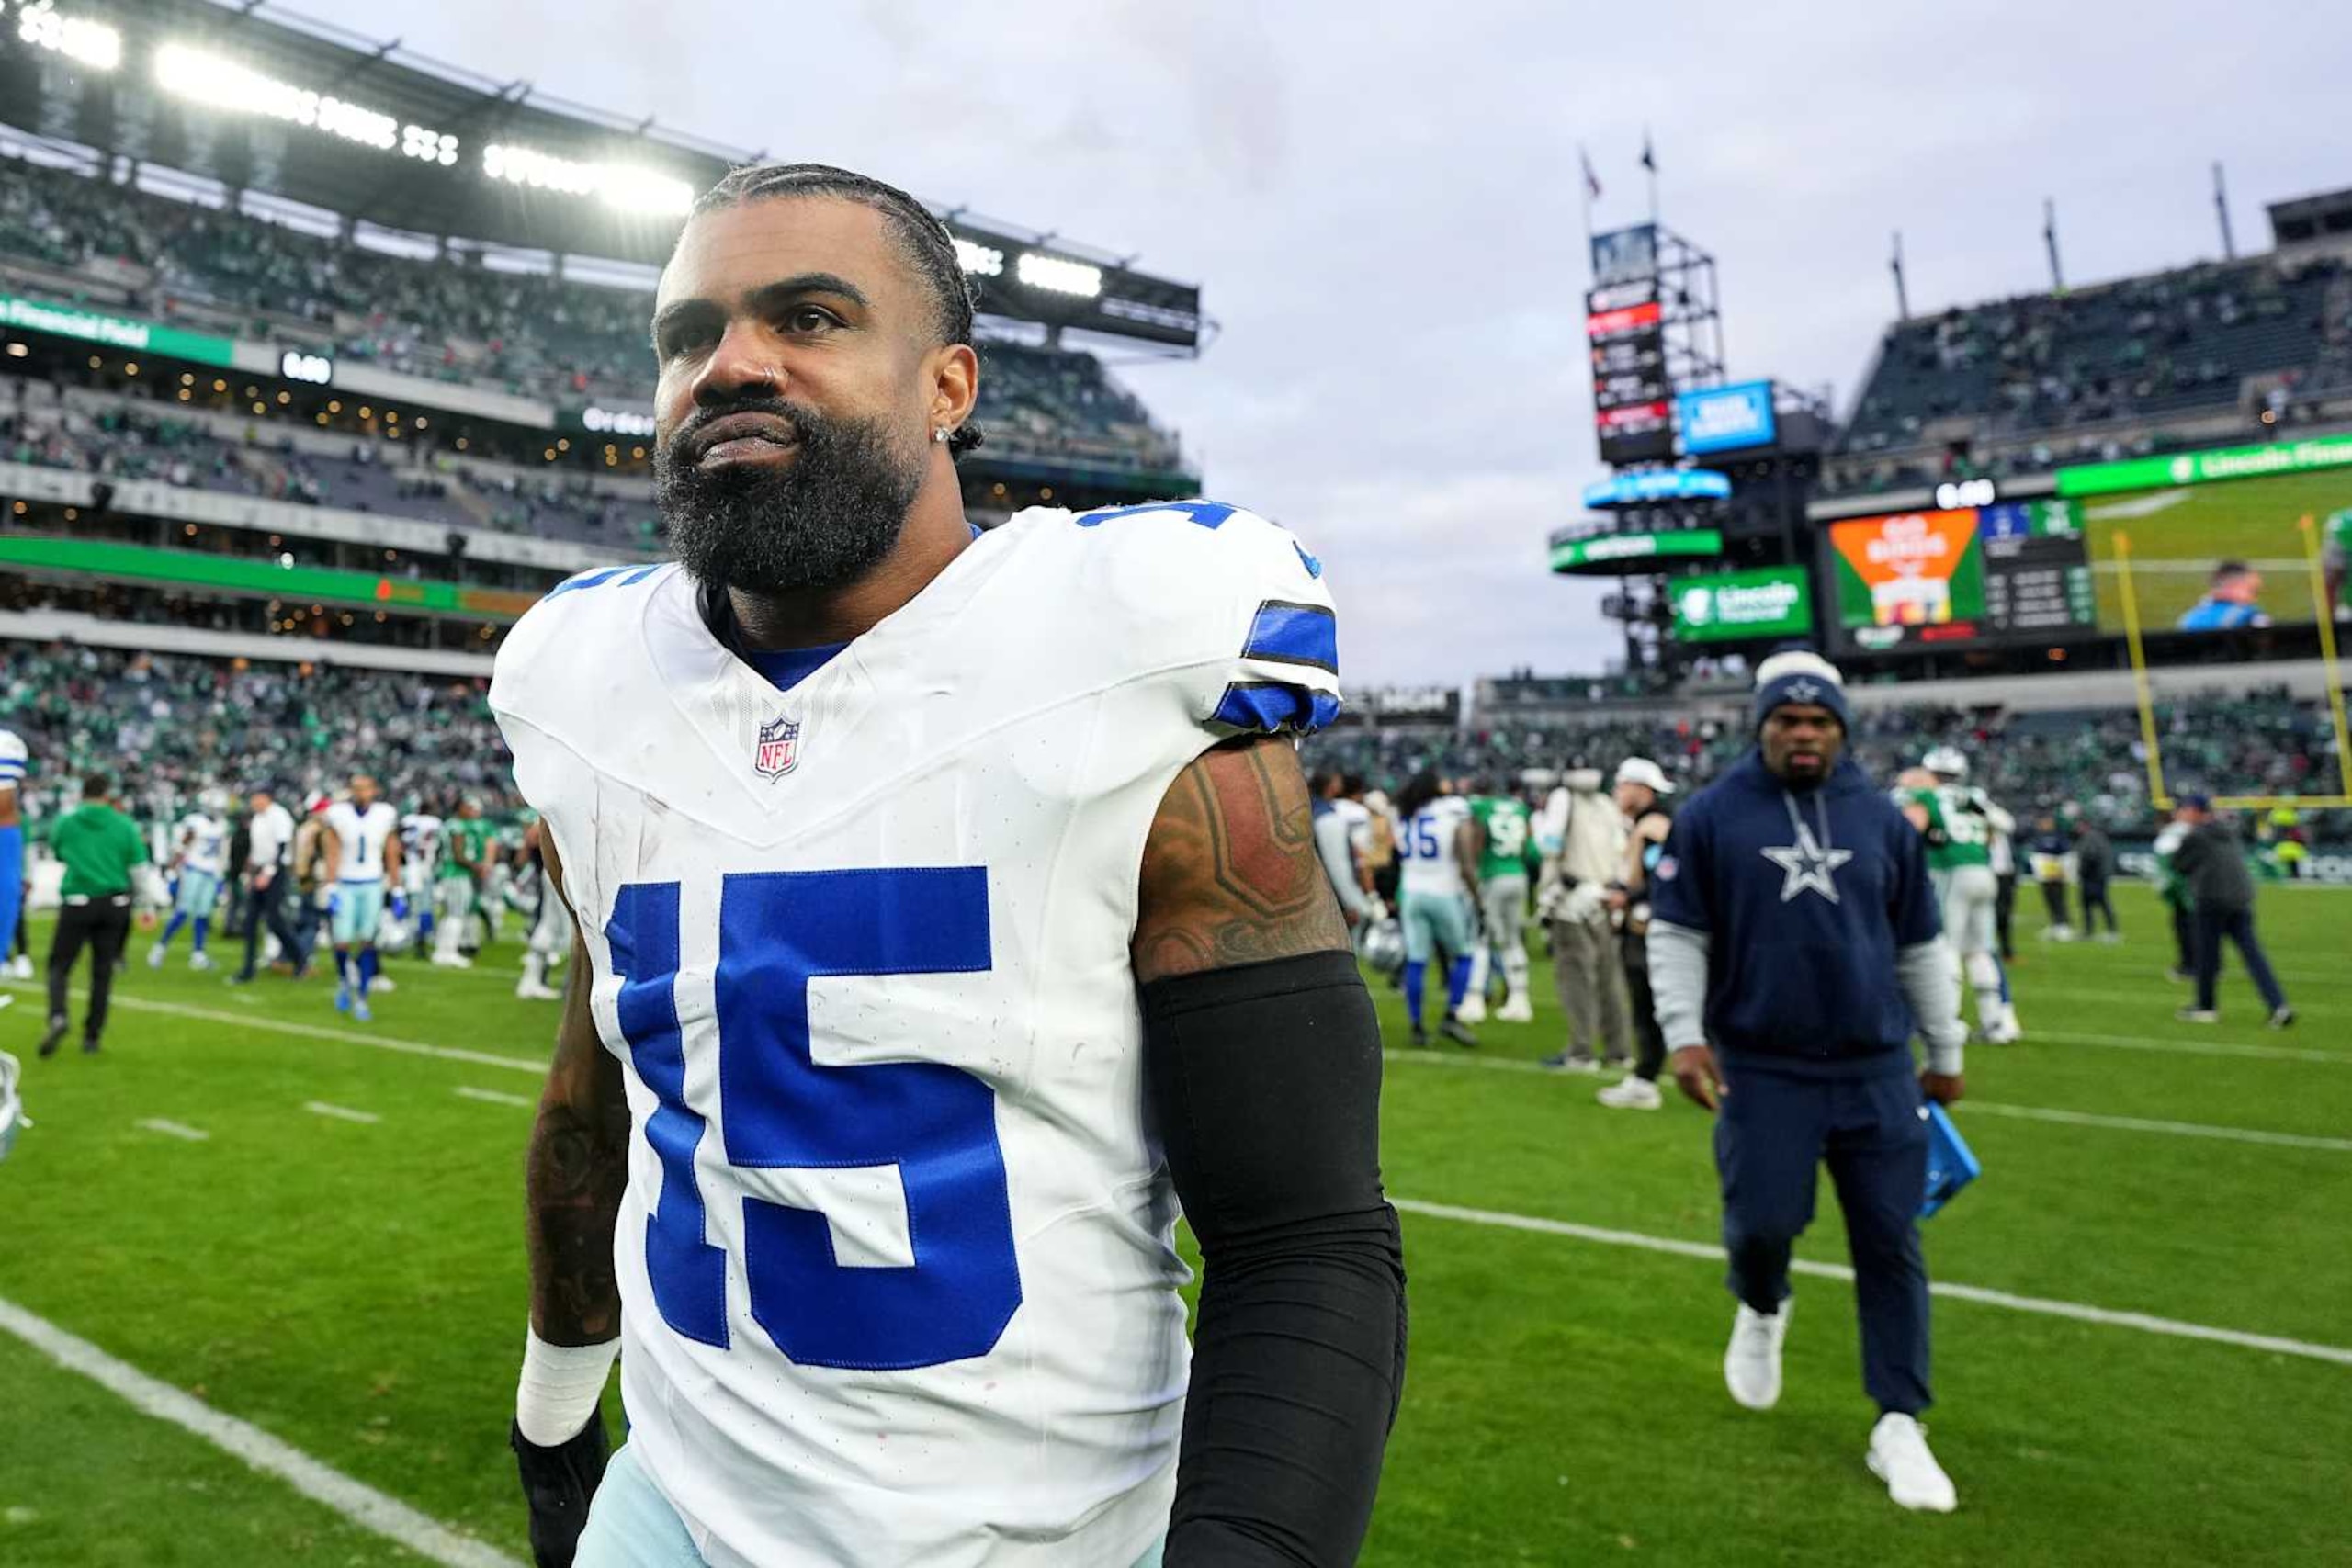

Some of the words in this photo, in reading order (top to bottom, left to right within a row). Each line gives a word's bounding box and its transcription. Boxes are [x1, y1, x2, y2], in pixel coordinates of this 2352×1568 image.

[760, 743, 792, 770] NFL
[357, 835, 366, 863] 1
[604, 866, 1023, 1369] 15
